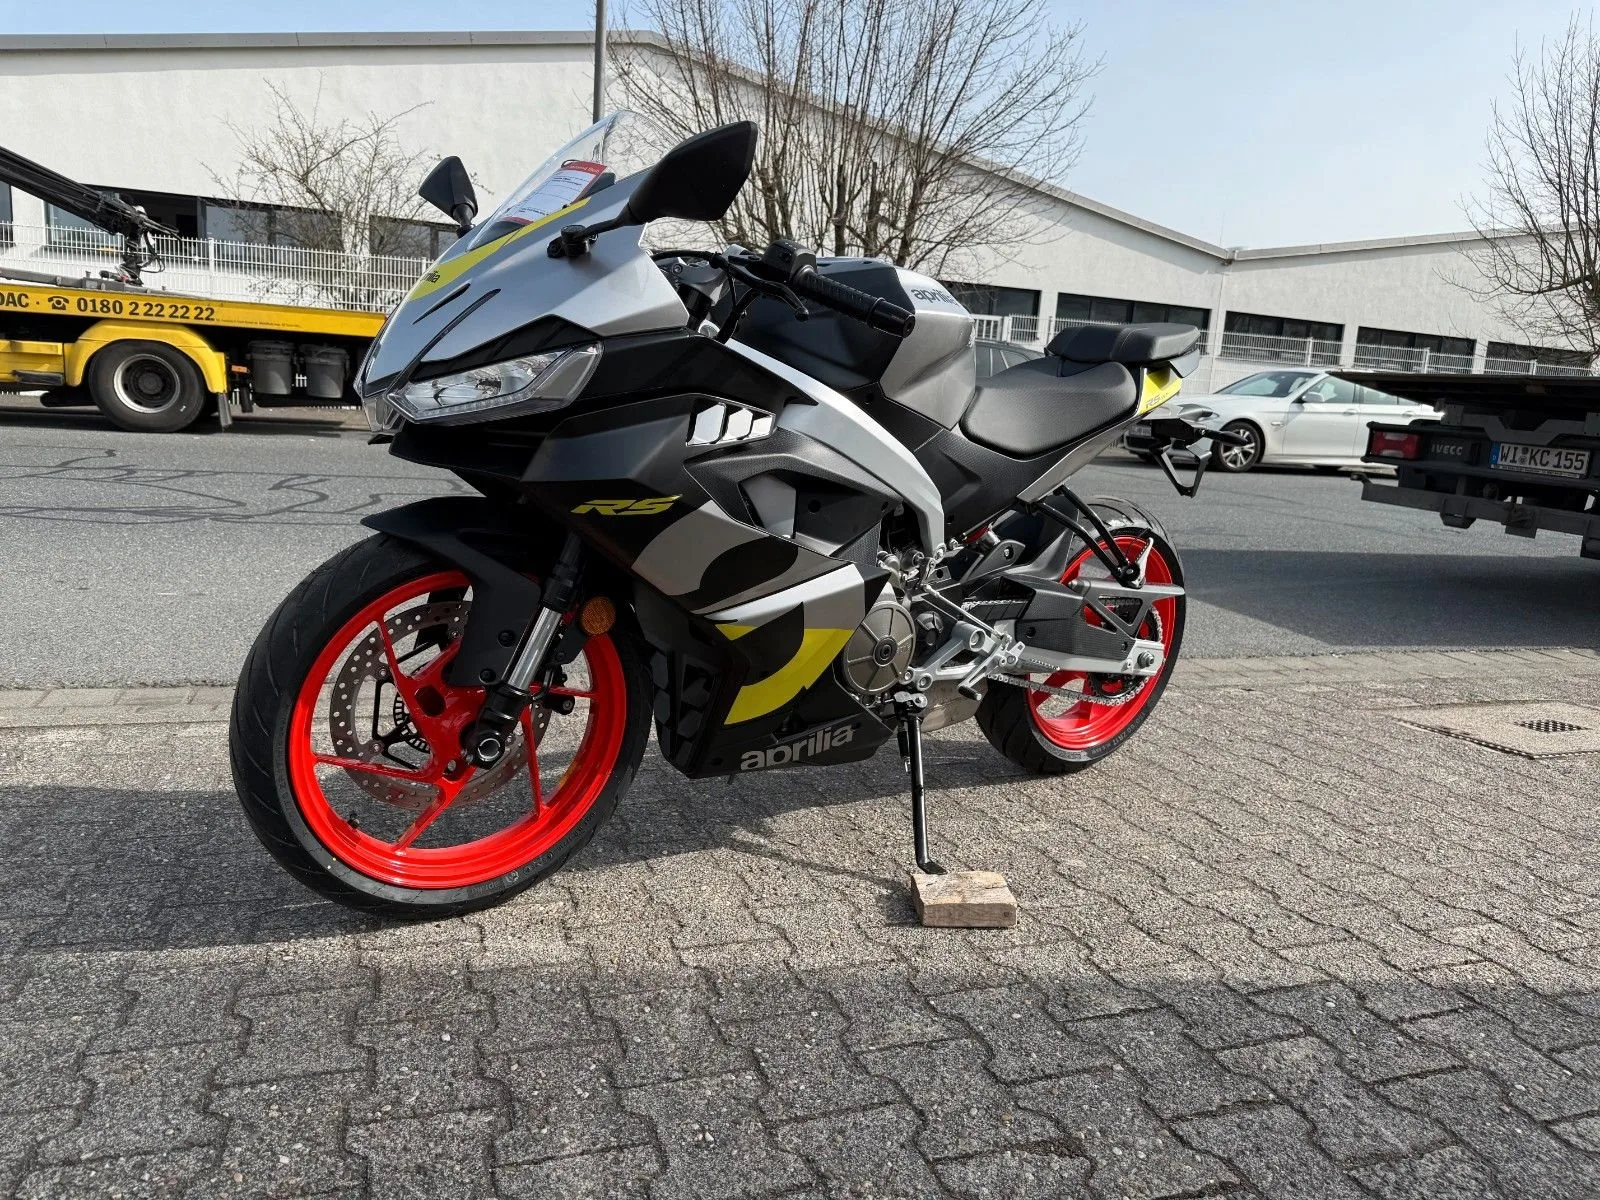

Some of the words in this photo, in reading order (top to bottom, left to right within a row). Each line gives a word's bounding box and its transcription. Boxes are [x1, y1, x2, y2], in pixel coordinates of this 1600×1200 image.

[76, 297, 123, 314] 0180
[1553, 450, 1586, 471] 155
[570, 494, 682, 516] RS
[740, 724, 856, 771] aprilia
